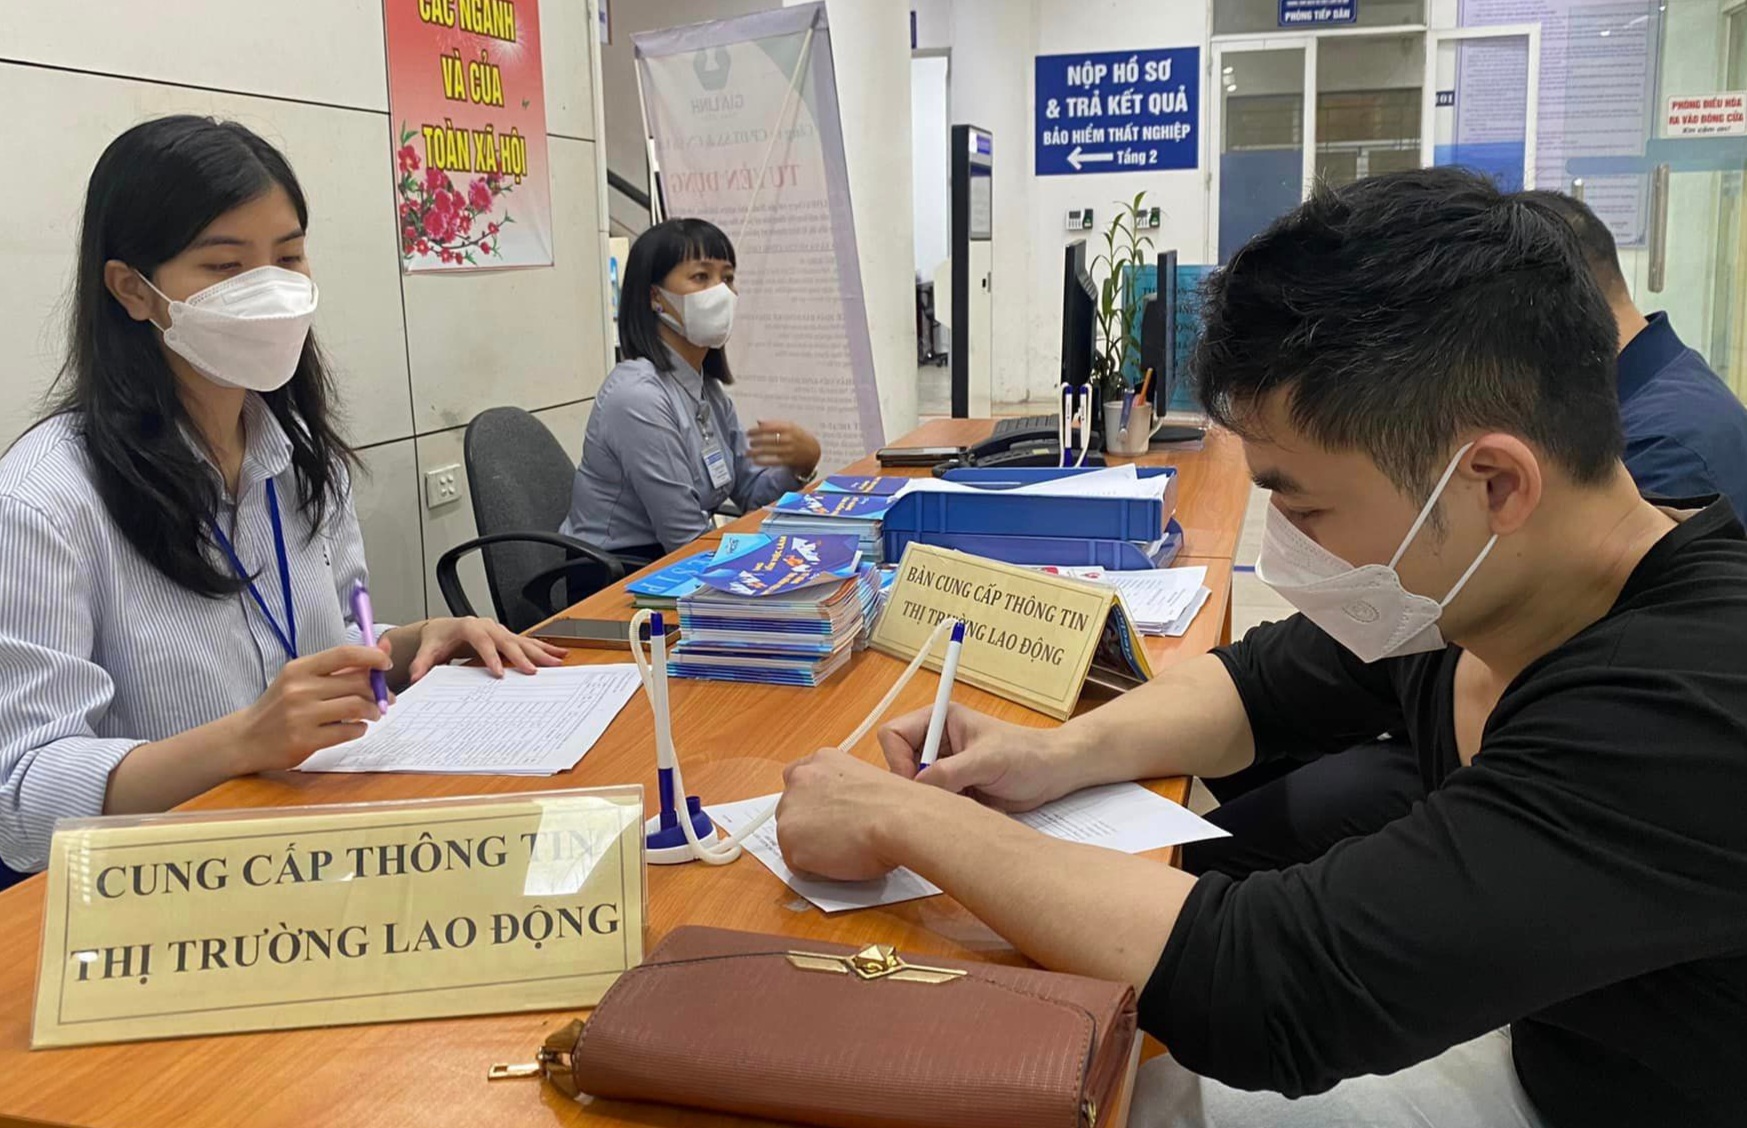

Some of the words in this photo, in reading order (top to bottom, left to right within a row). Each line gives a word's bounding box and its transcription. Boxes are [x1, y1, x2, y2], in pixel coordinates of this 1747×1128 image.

[440, 48, 467, 101] VÀ
[468, 49, 505, 107] CỦA
[1046, 98, 1060, 119] &
[1066, 89, 1102, 118] TRẢ
[1108, 87, 1143, 116] KẾT
[1148, 84, 1188, 116] QUẢ
[1067, 60, 1107, 90] NỘP
[1144, 58, 1172, 82] SƠ
[1043, 125, 1069, 146] BẢO
[1072, 123, 1105, 144] HIỂM
[1108, 122, 1139, 142] THẤT
[1142, 121, 1190, 143] NGHIỆP
[1669, 115, 1680, 125] RA
[421, 117, 471, 172] TOÀN
[472, 124, 498, 175] XÃ
[499, 127, 528, 184] HỘI
[1149, 149, 1158, 164] 2
[907, 565, 935, 587] BÀN
[935, 575, 973, 598] CUNG
[973, 583, 1002, 606] CẤP
[1003, 593, 1058, 623] THÔNG
[1059, 608, 1089, 632] TIN
[903, 600, 926, 625] THỊ
[927, 608, 987, 641] TRNG
[987, 627, 1017, 650] LAO
[1019, 637, 1065, 666] ĐỘNG
[96, 857, 228, 899] CUNG
[242, 841, 333, 886] CẤP
[346, 832, 508, 879] THÔNG
[70, 943, 154, 985] THỊ
[167, 926, 369, 973] TRƯỜNG
[382, 915, 477, 955] LAO
[490, 901, 619, 950] ĐỘNG
